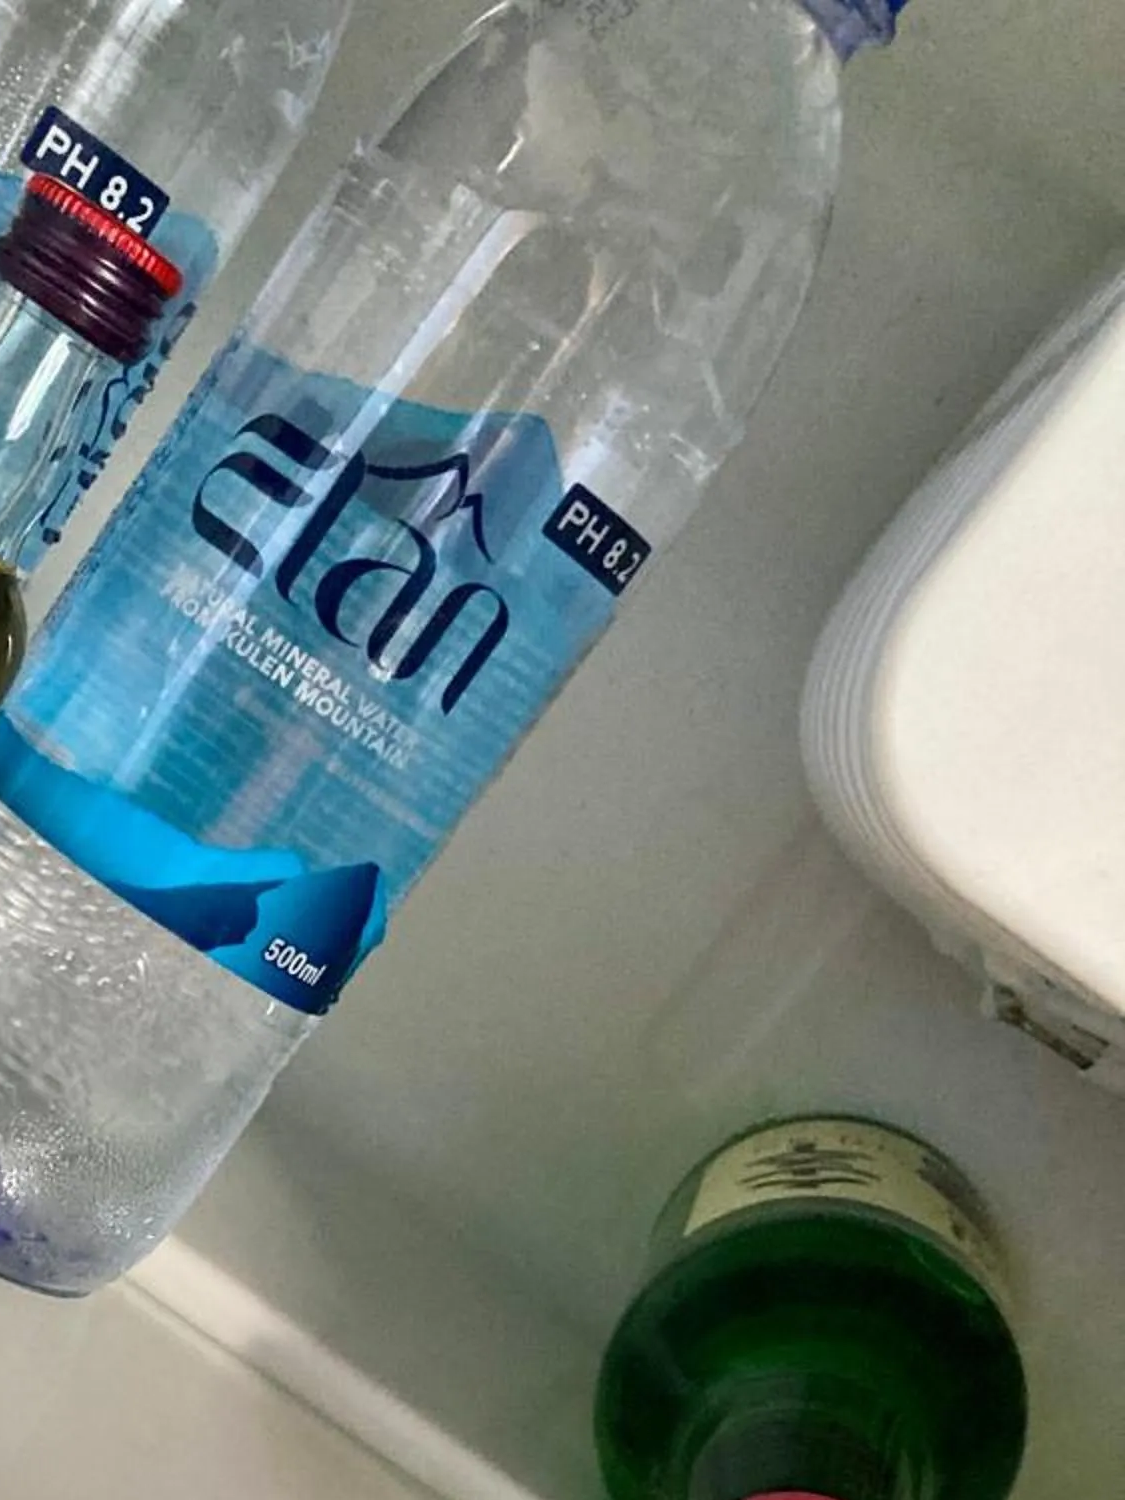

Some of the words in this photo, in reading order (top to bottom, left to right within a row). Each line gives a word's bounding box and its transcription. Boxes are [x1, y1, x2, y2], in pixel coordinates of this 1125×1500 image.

[35, 125, 100, 190] PH
[100, 175, 154, 234] 8.2
[557, 500, 610, 555] PH
[603, 538, 640, 583] 8.2
[219, 626, 296, 688] KULEN
[292, 678, 412, 771] MOUNTAIN
[261, 627, 353, 705] MINERAL
[265, 939, 327, 988] 500ml
